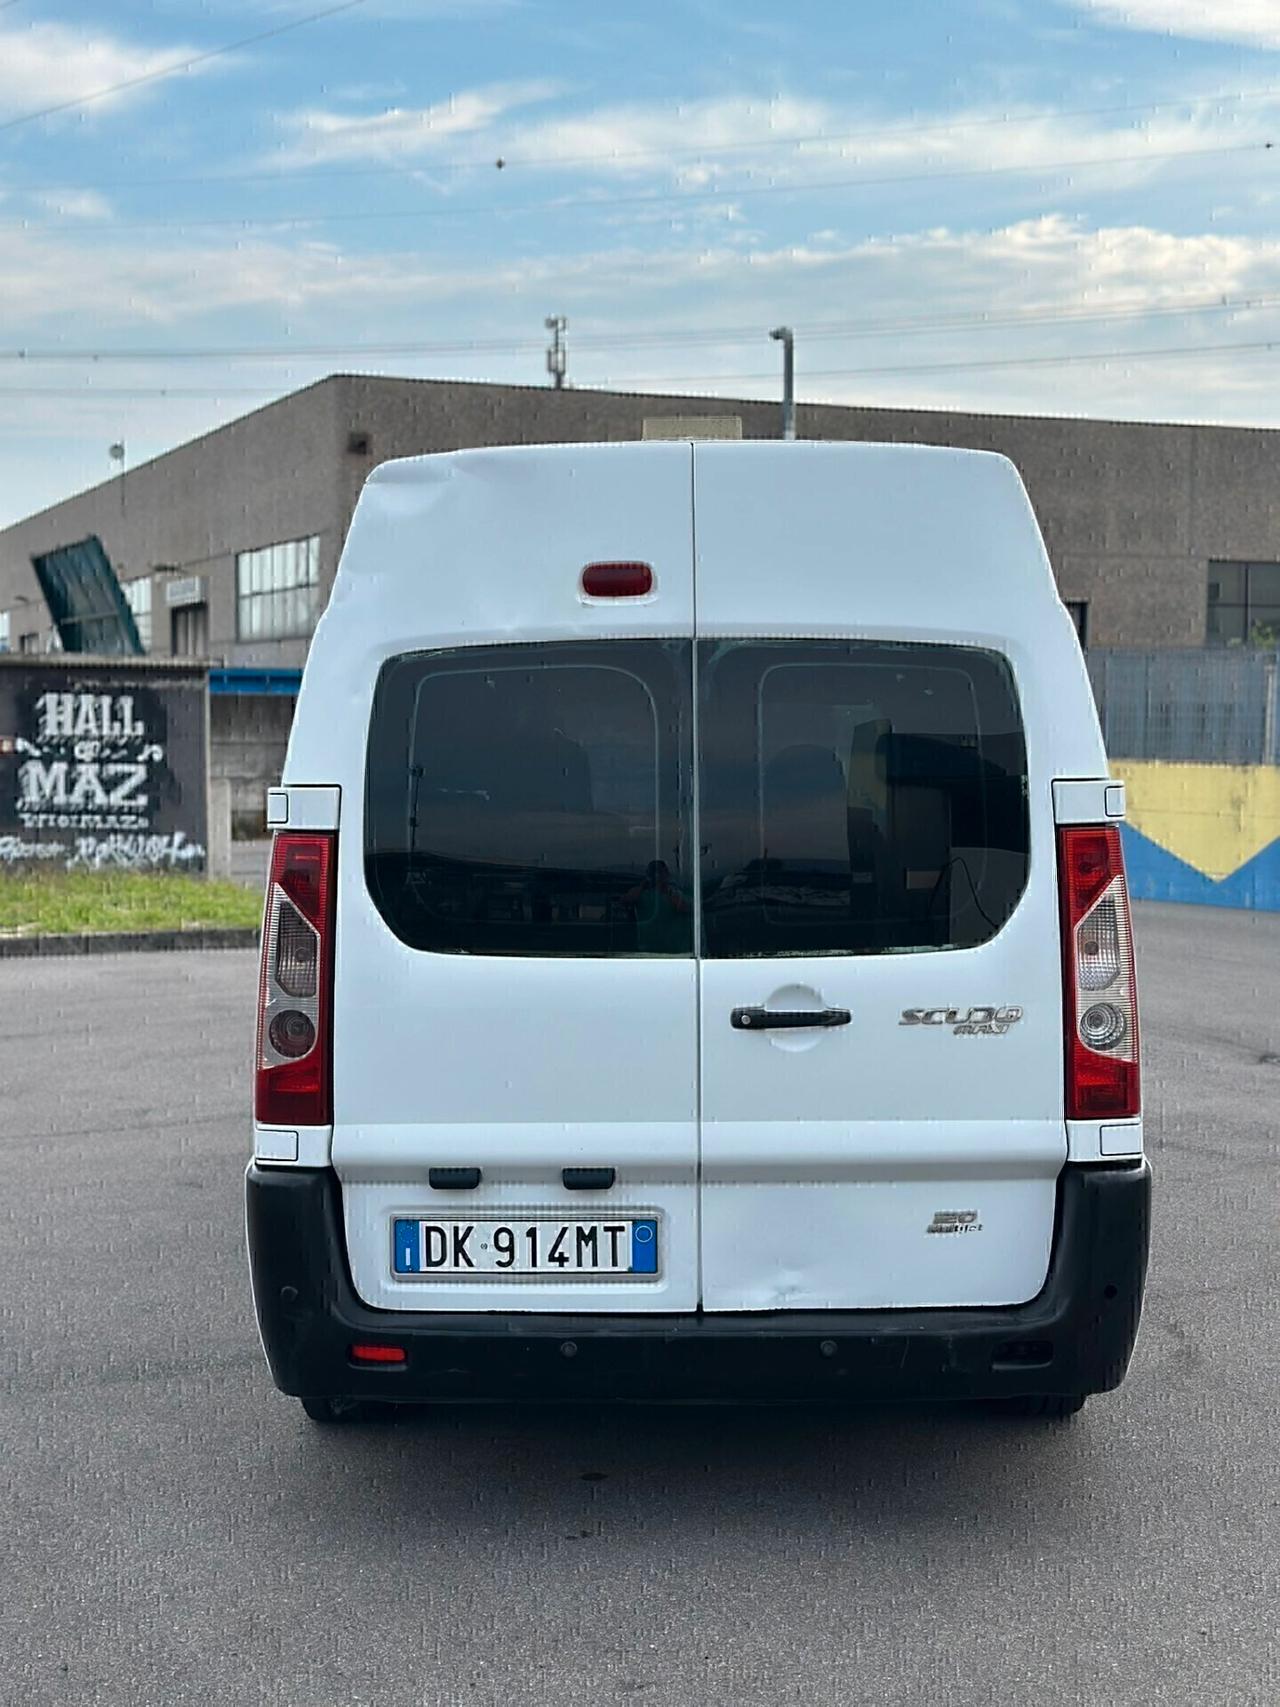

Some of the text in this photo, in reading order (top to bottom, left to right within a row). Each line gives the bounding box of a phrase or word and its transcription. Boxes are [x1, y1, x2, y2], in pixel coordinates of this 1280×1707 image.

[37, 693, 145, 740] HALL
[17, 760, 149, 808] MAZ
[898, 1006, 1023, 1026] SCUDO
[425, 1226, 475, 1268] DK
[493, 1226, 626, 1268] 914MT
